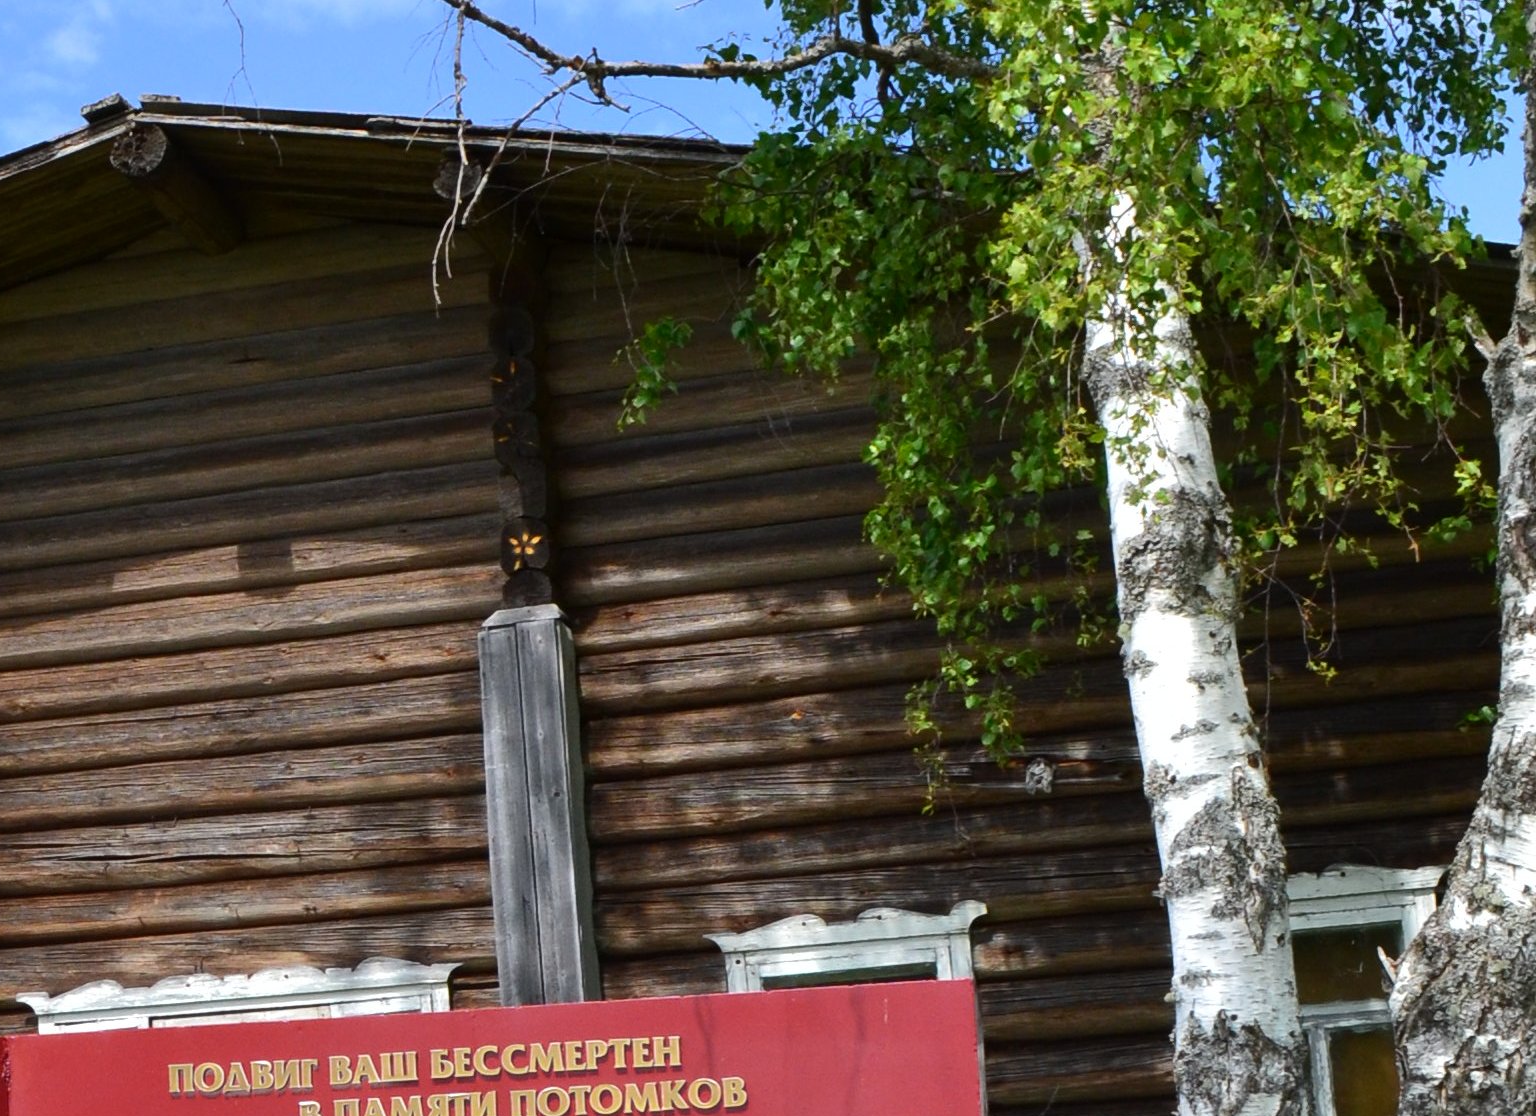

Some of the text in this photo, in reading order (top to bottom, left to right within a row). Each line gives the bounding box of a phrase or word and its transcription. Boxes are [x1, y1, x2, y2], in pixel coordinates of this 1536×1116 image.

[168, 1036, 682, 1094] ПОДВИГ ВАШ БЕССМЕРТЕН
